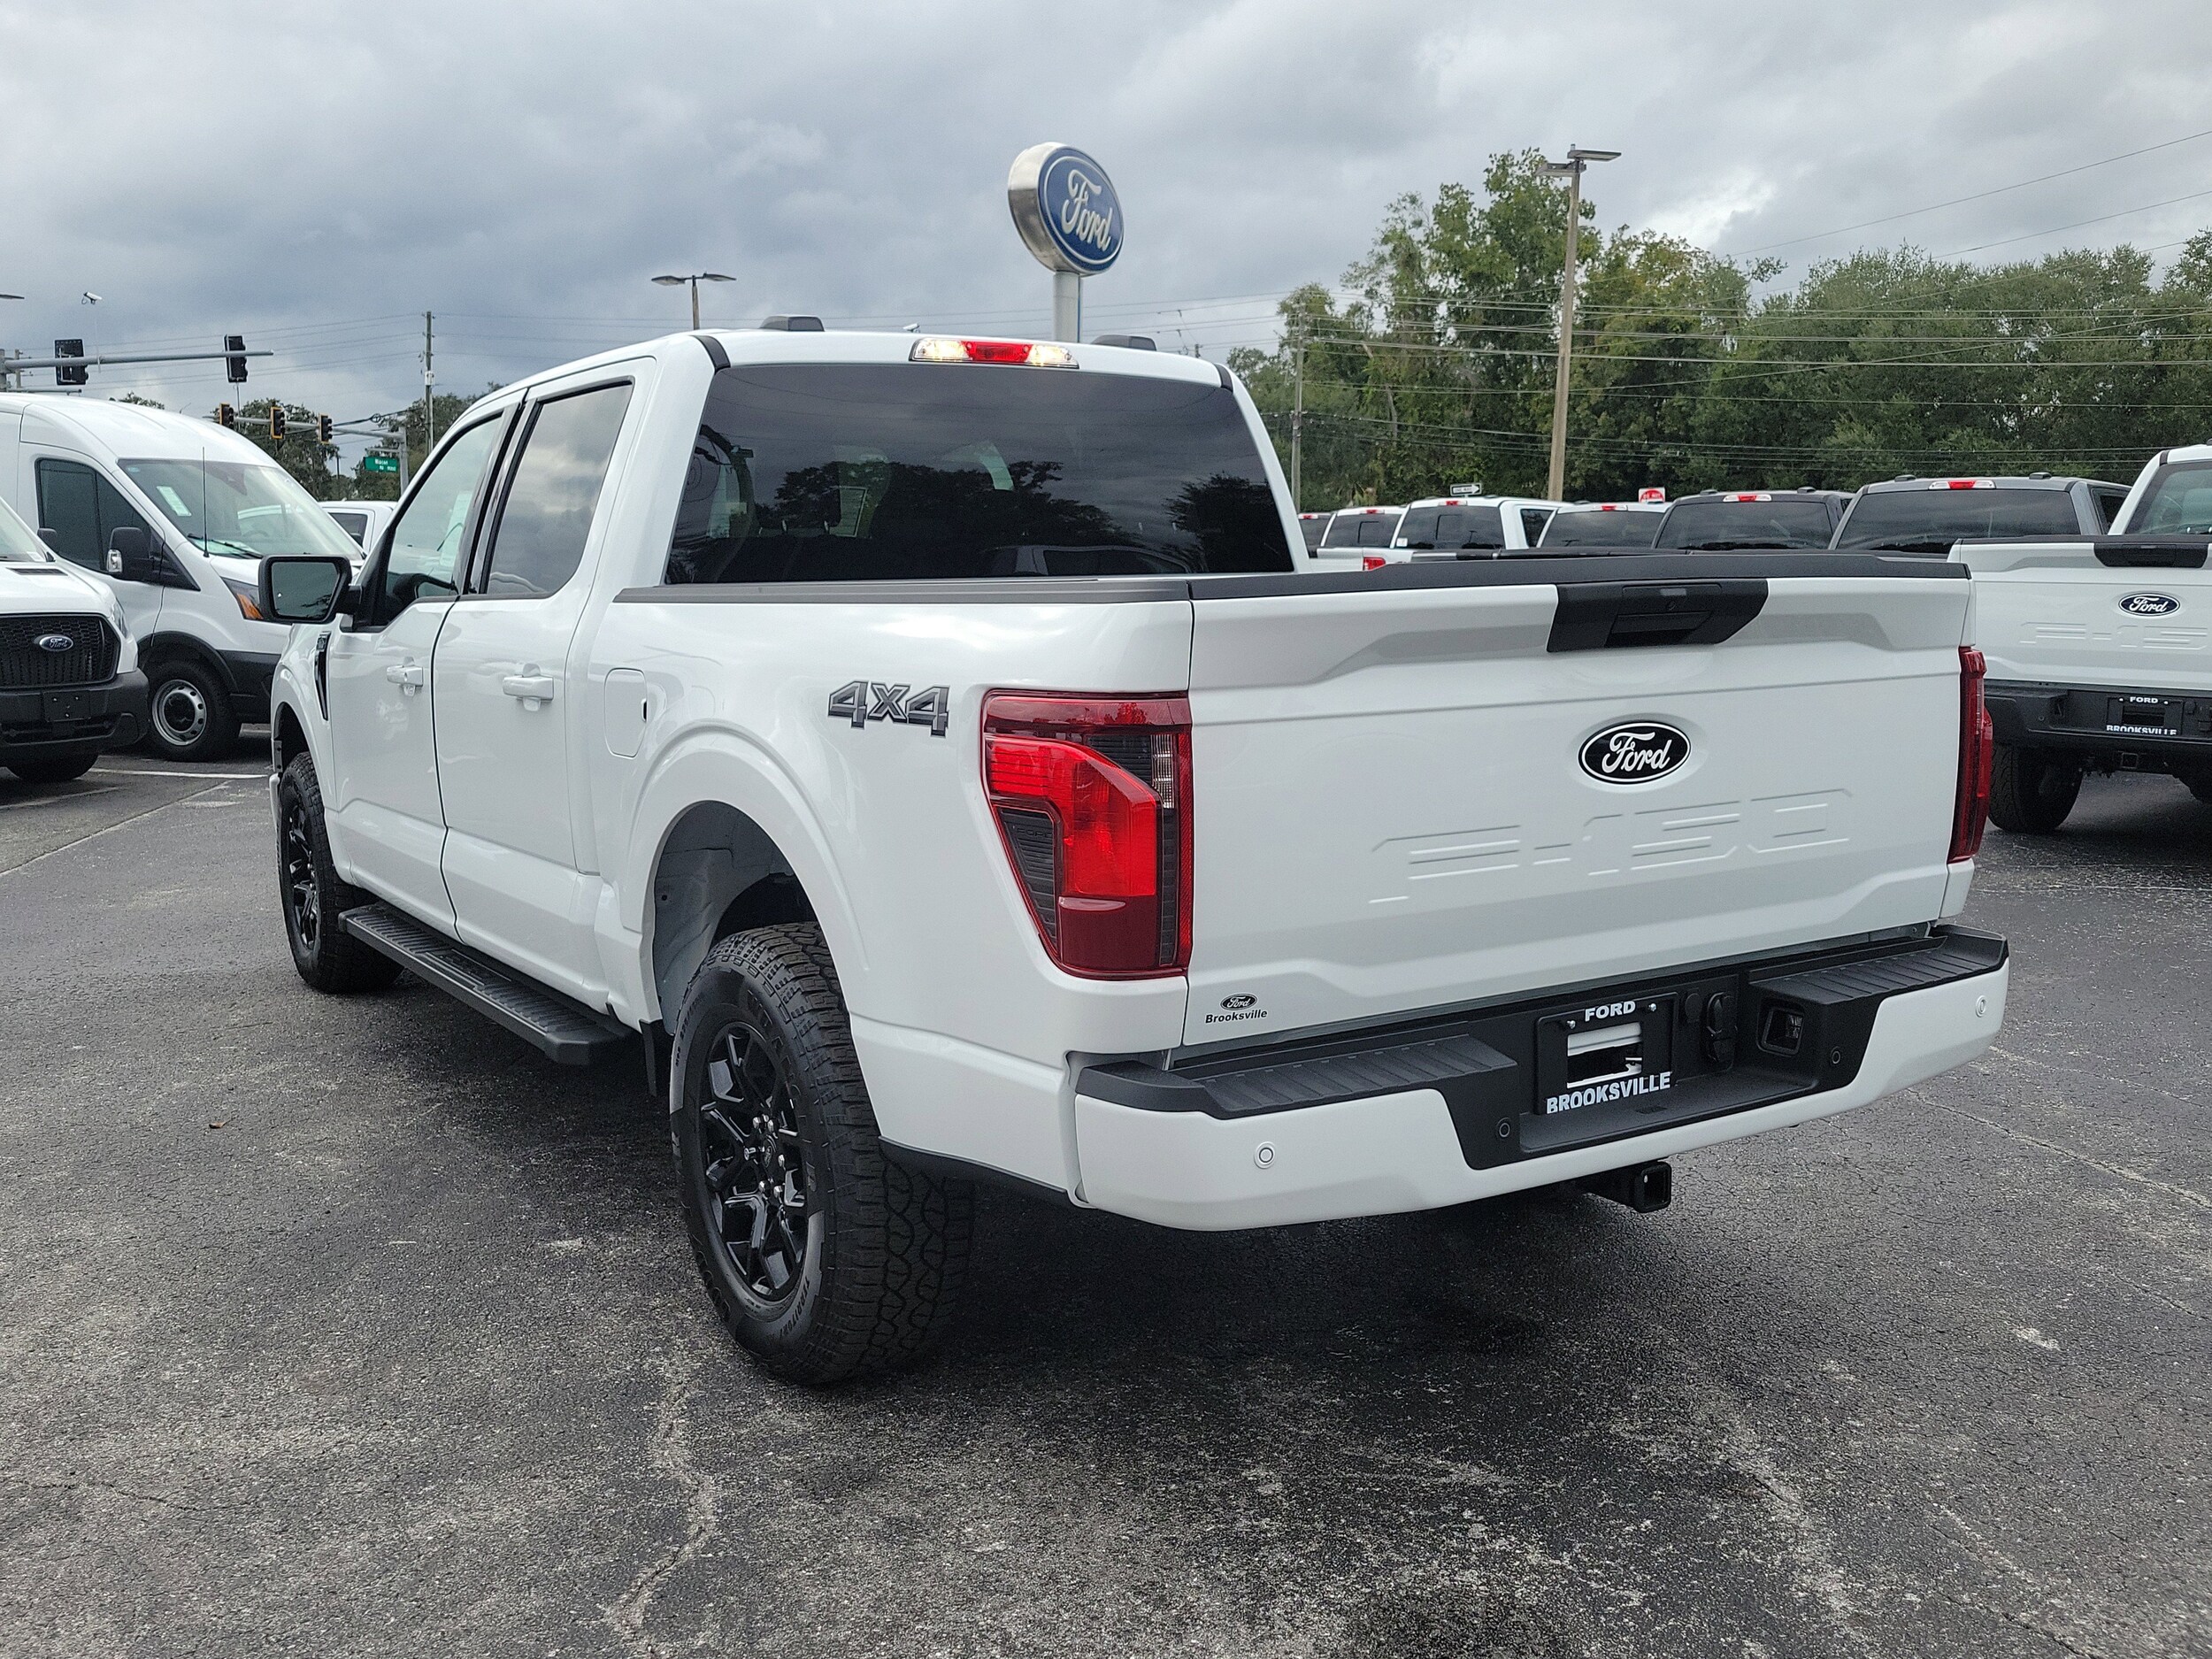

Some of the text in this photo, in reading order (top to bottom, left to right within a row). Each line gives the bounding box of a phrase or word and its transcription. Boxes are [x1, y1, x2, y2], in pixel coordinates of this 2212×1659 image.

[1062, 169, 1112, 251] Ford
[2129, 595, 2169, 612] Ford
[50, 638, 68, 648] Ford
[2129, 695, 2159, 704] FORD
[2106, 724, 2177, 735] BROOKSVILLE
[1601, 731, 1673, 773] Ford
[1368, 788, 1854, 903] F-150
[1226, 995, 1251, 1008] Ford
[1205, 1009, 1268, 1024] Brooksville
[1584, 1001, 1637, 1022] FORD
[1547, 1071, 1671, 1115] BROOKSVILLE
